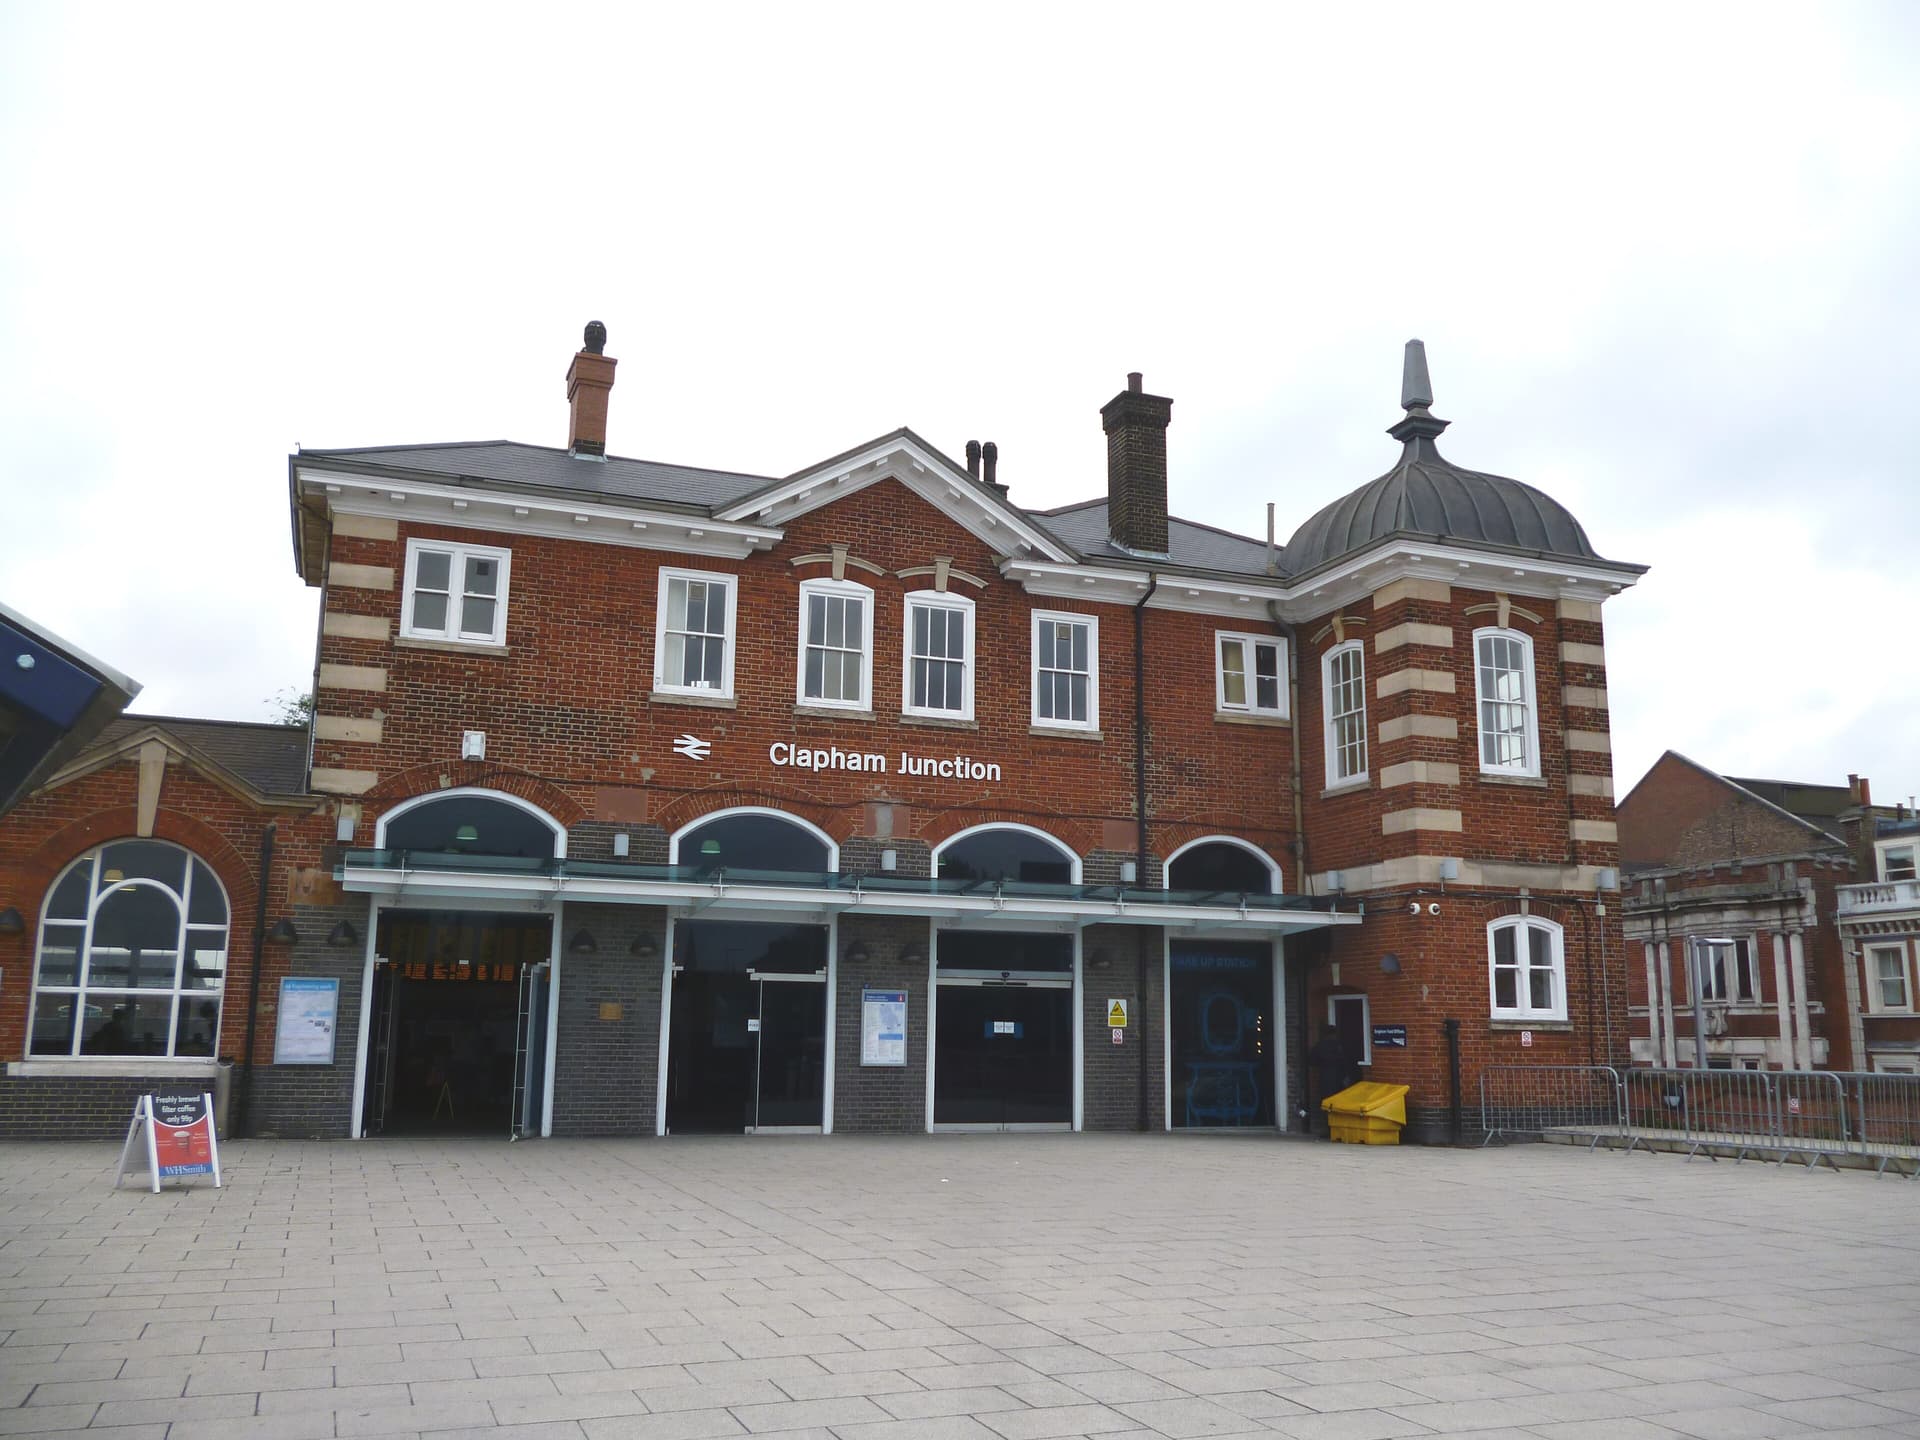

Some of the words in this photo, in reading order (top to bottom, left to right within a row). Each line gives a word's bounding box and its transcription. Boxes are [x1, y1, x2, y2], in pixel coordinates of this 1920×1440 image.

[769, 742, 886, 772] Clapham
[897, 752, 1001, 781] Junction
[155, 1095, 177, 1104] Freshly
[162, 1105, 176, 1113] filter
[177, 1104, 196, 1112] coffee
[166, 1115, 180, 1123] only
[180, 1114, 193, 1123] 99p
[165, 1164, 207, 1175] WHSmith
